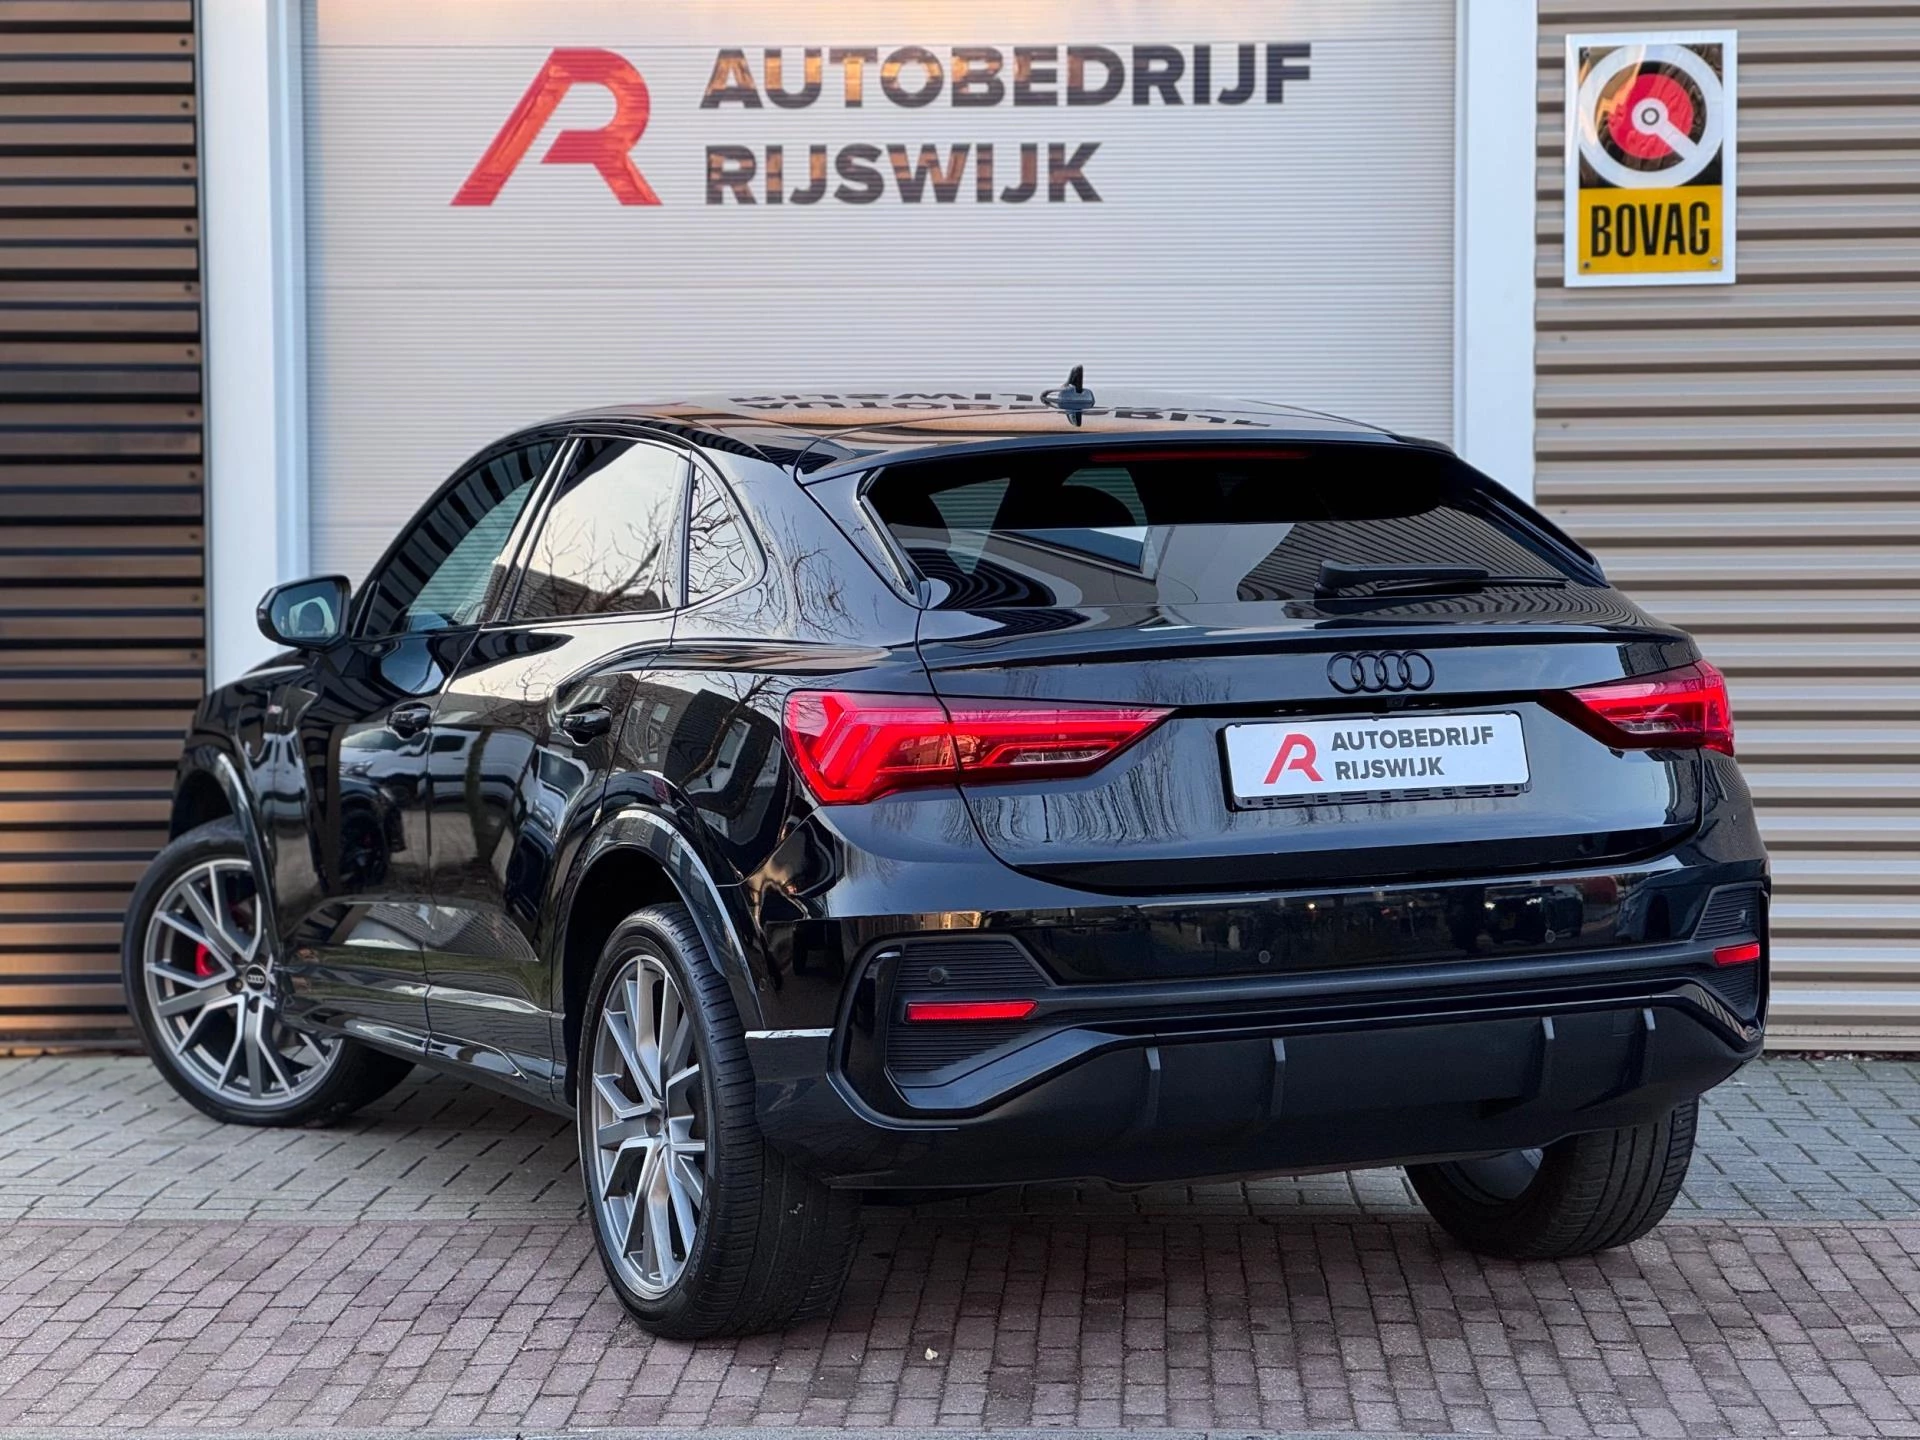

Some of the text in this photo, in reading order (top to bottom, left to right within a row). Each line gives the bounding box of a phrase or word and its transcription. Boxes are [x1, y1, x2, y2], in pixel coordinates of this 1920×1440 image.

[701, 43, 1312, 109] AUTOBEDRIJF
[706, 143, 1102, 205] RIJSWIJK
[1591, 201, 1710, 257] BOVAG
[1331, 726, 1494, 751] AUTOBEDRIJF
[1335, 756, 1445, 780] RIJSWIJK
